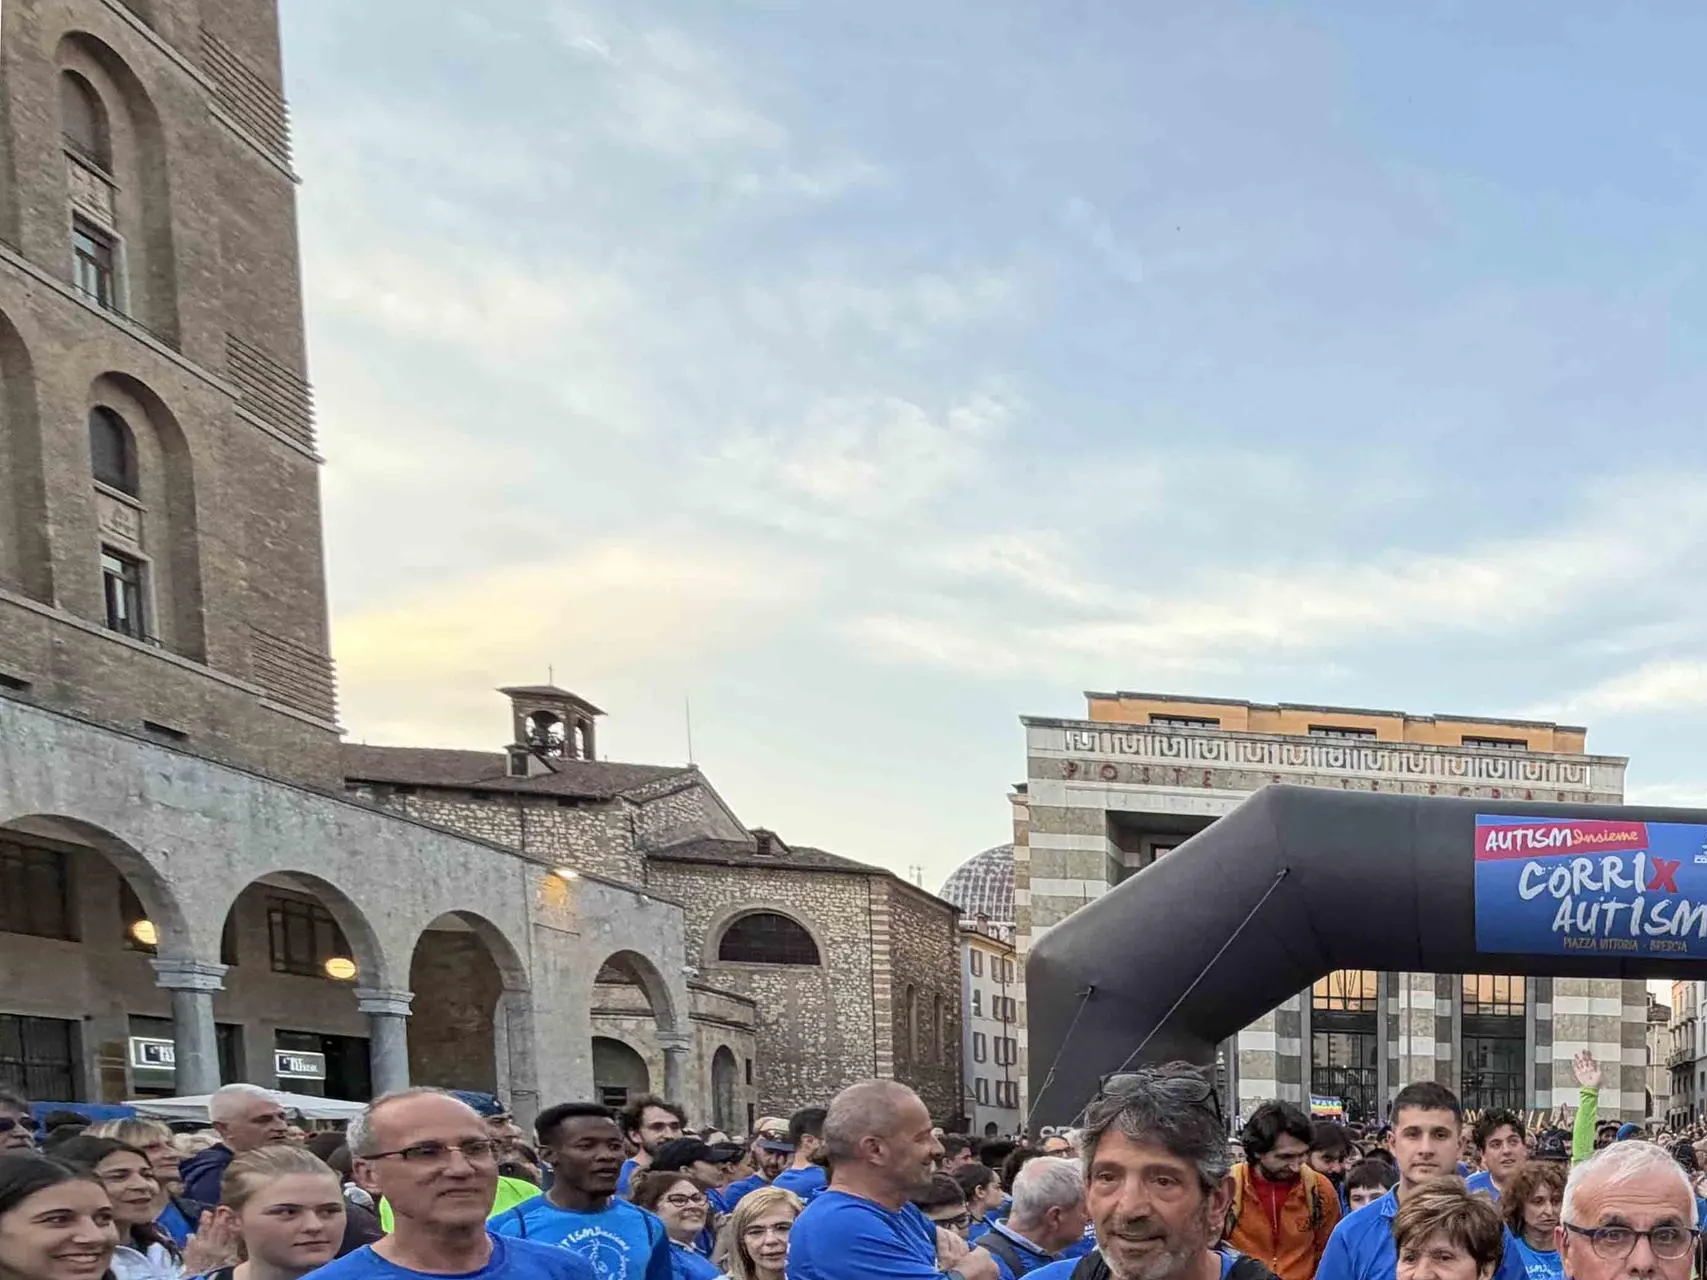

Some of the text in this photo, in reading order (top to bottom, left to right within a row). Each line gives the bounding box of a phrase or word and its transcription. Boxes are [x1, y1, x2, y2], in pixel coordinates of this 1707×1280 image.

[1563, 936, 1597, 949] PIAZZA
[1599, 937, 1639, 951] VITTORIA
[1649, 939, 1688, 953] BRESCIA
